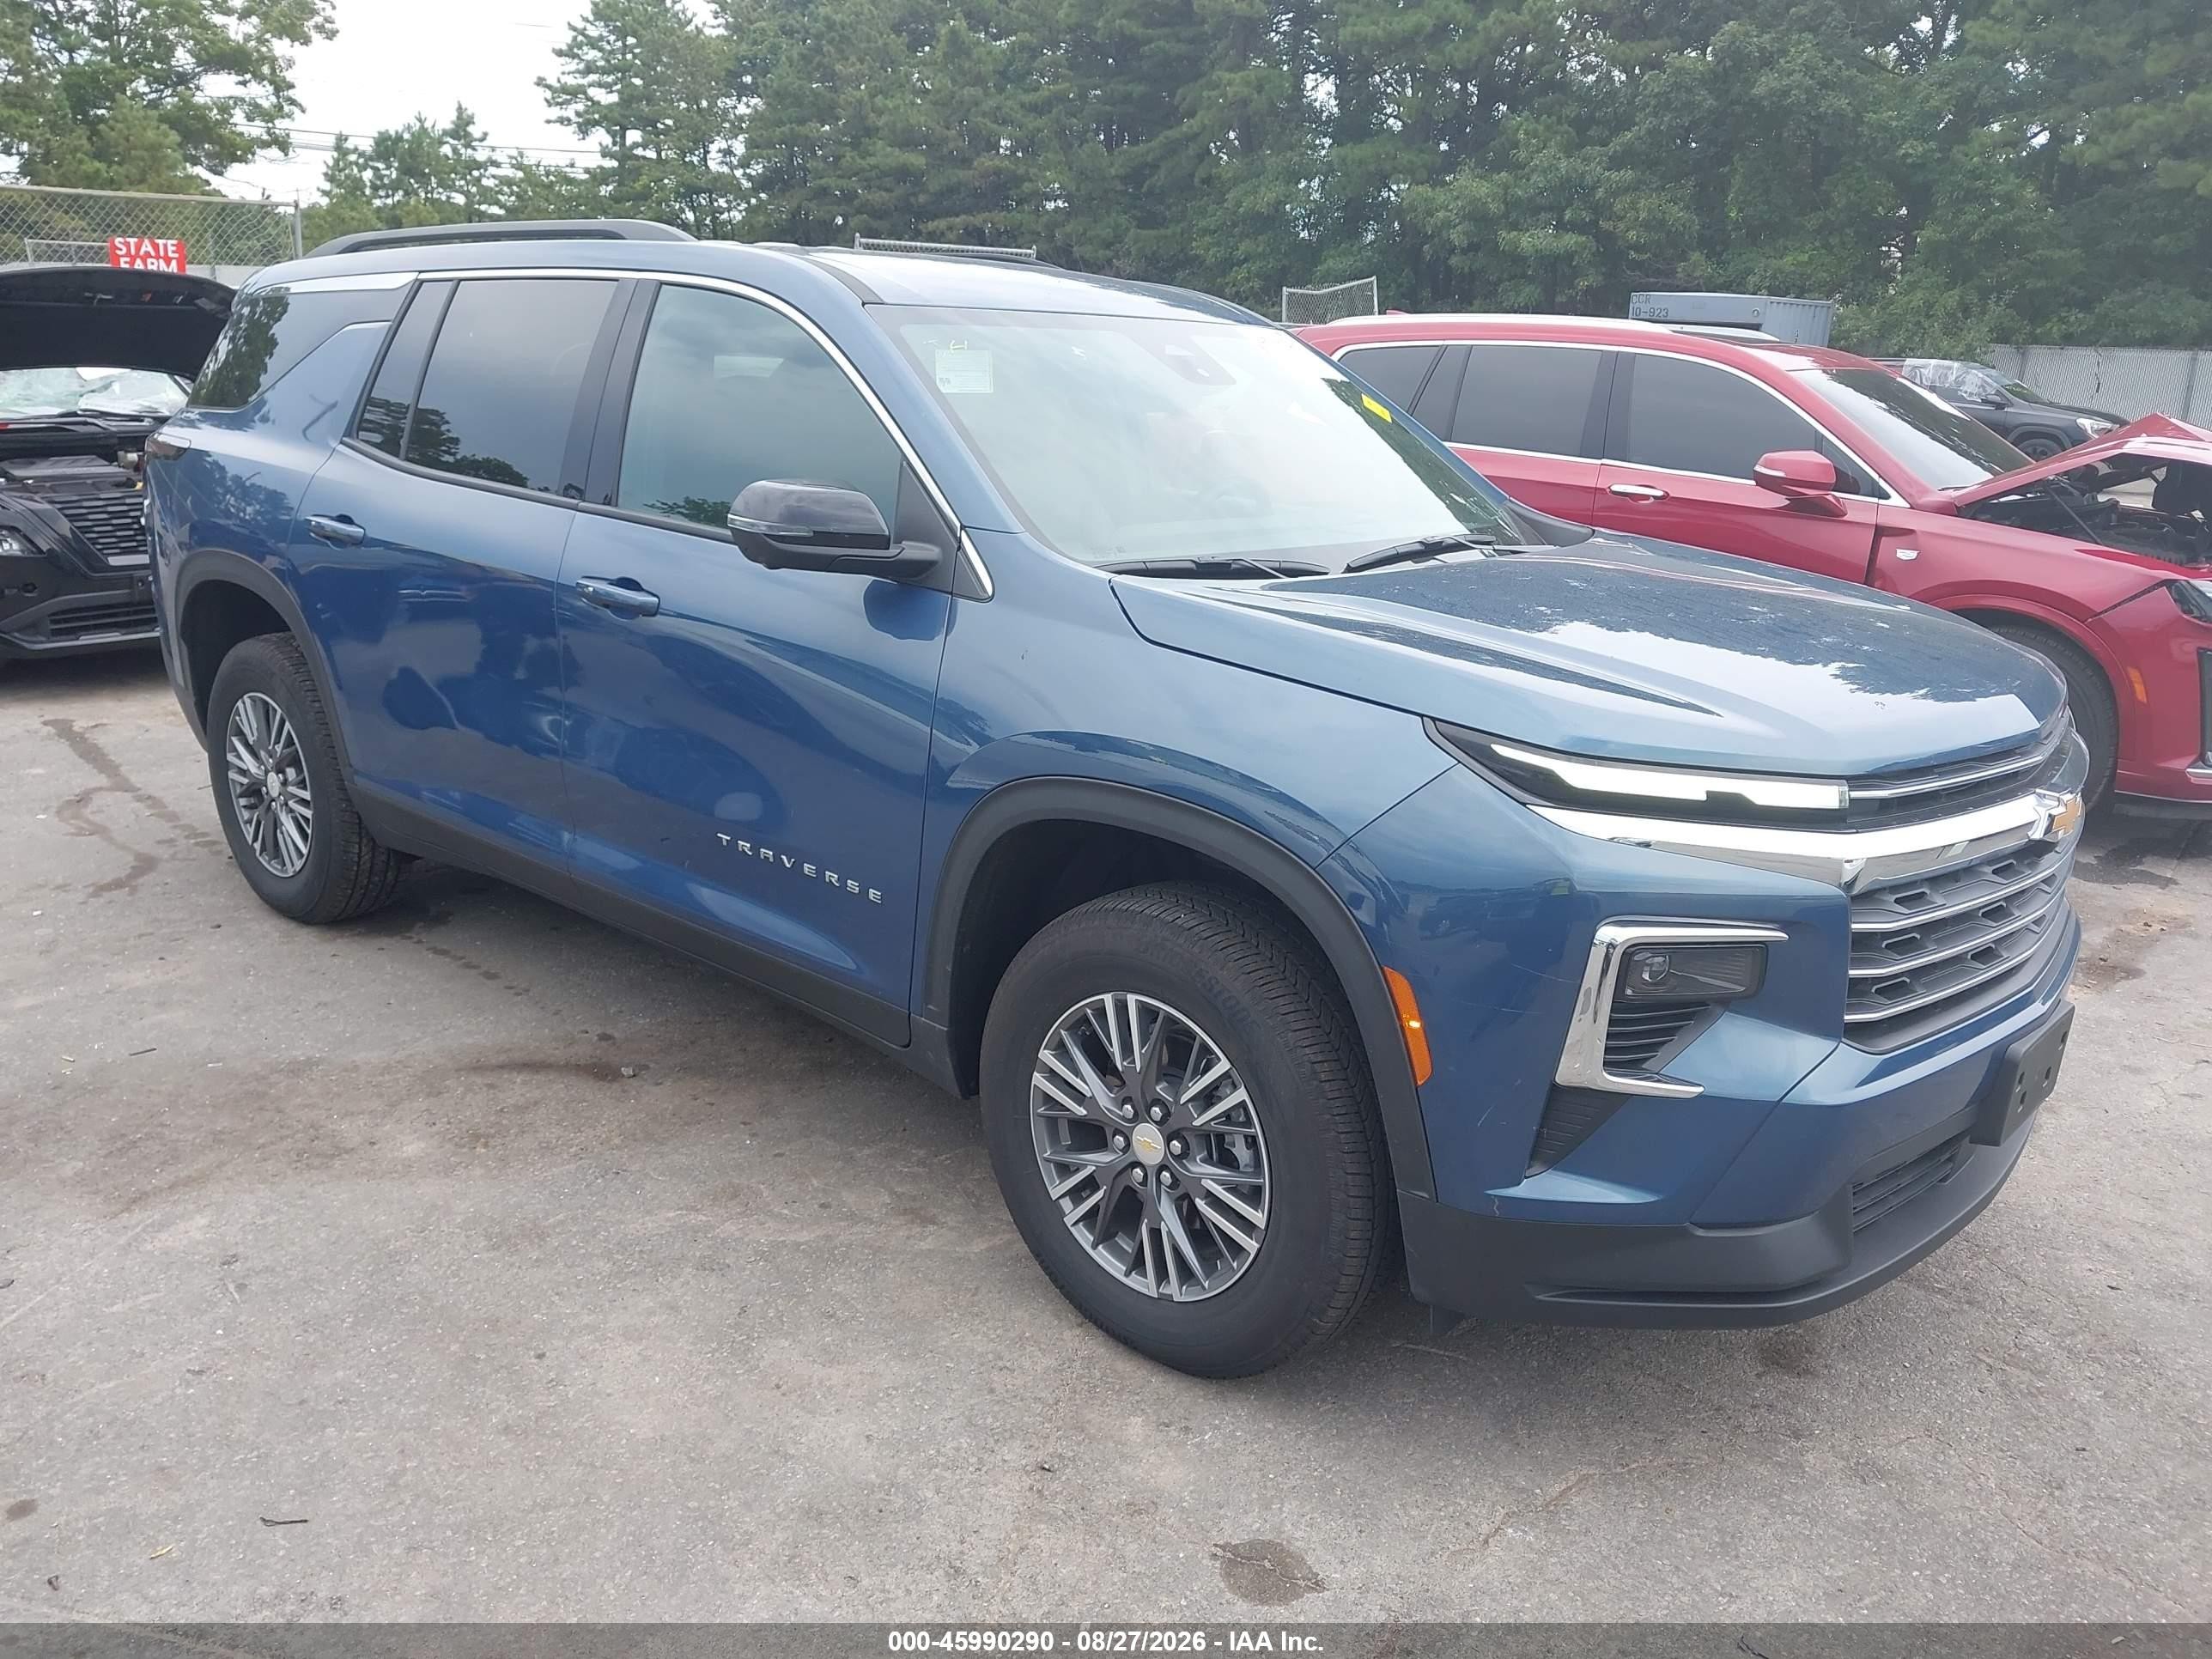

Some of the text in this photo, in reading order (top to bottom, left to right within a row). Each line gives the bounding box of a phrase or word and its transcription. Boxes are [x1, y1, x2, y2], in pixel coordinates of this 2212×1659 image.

[114, 237, 179, 258] STATE
[119, 257, 179, 273] FARM
[1632, 294, 1651, 304] CCR
[1632, 306, 1670, 319] 10-923
[716, 833, 883, 904] TRAVERSE
